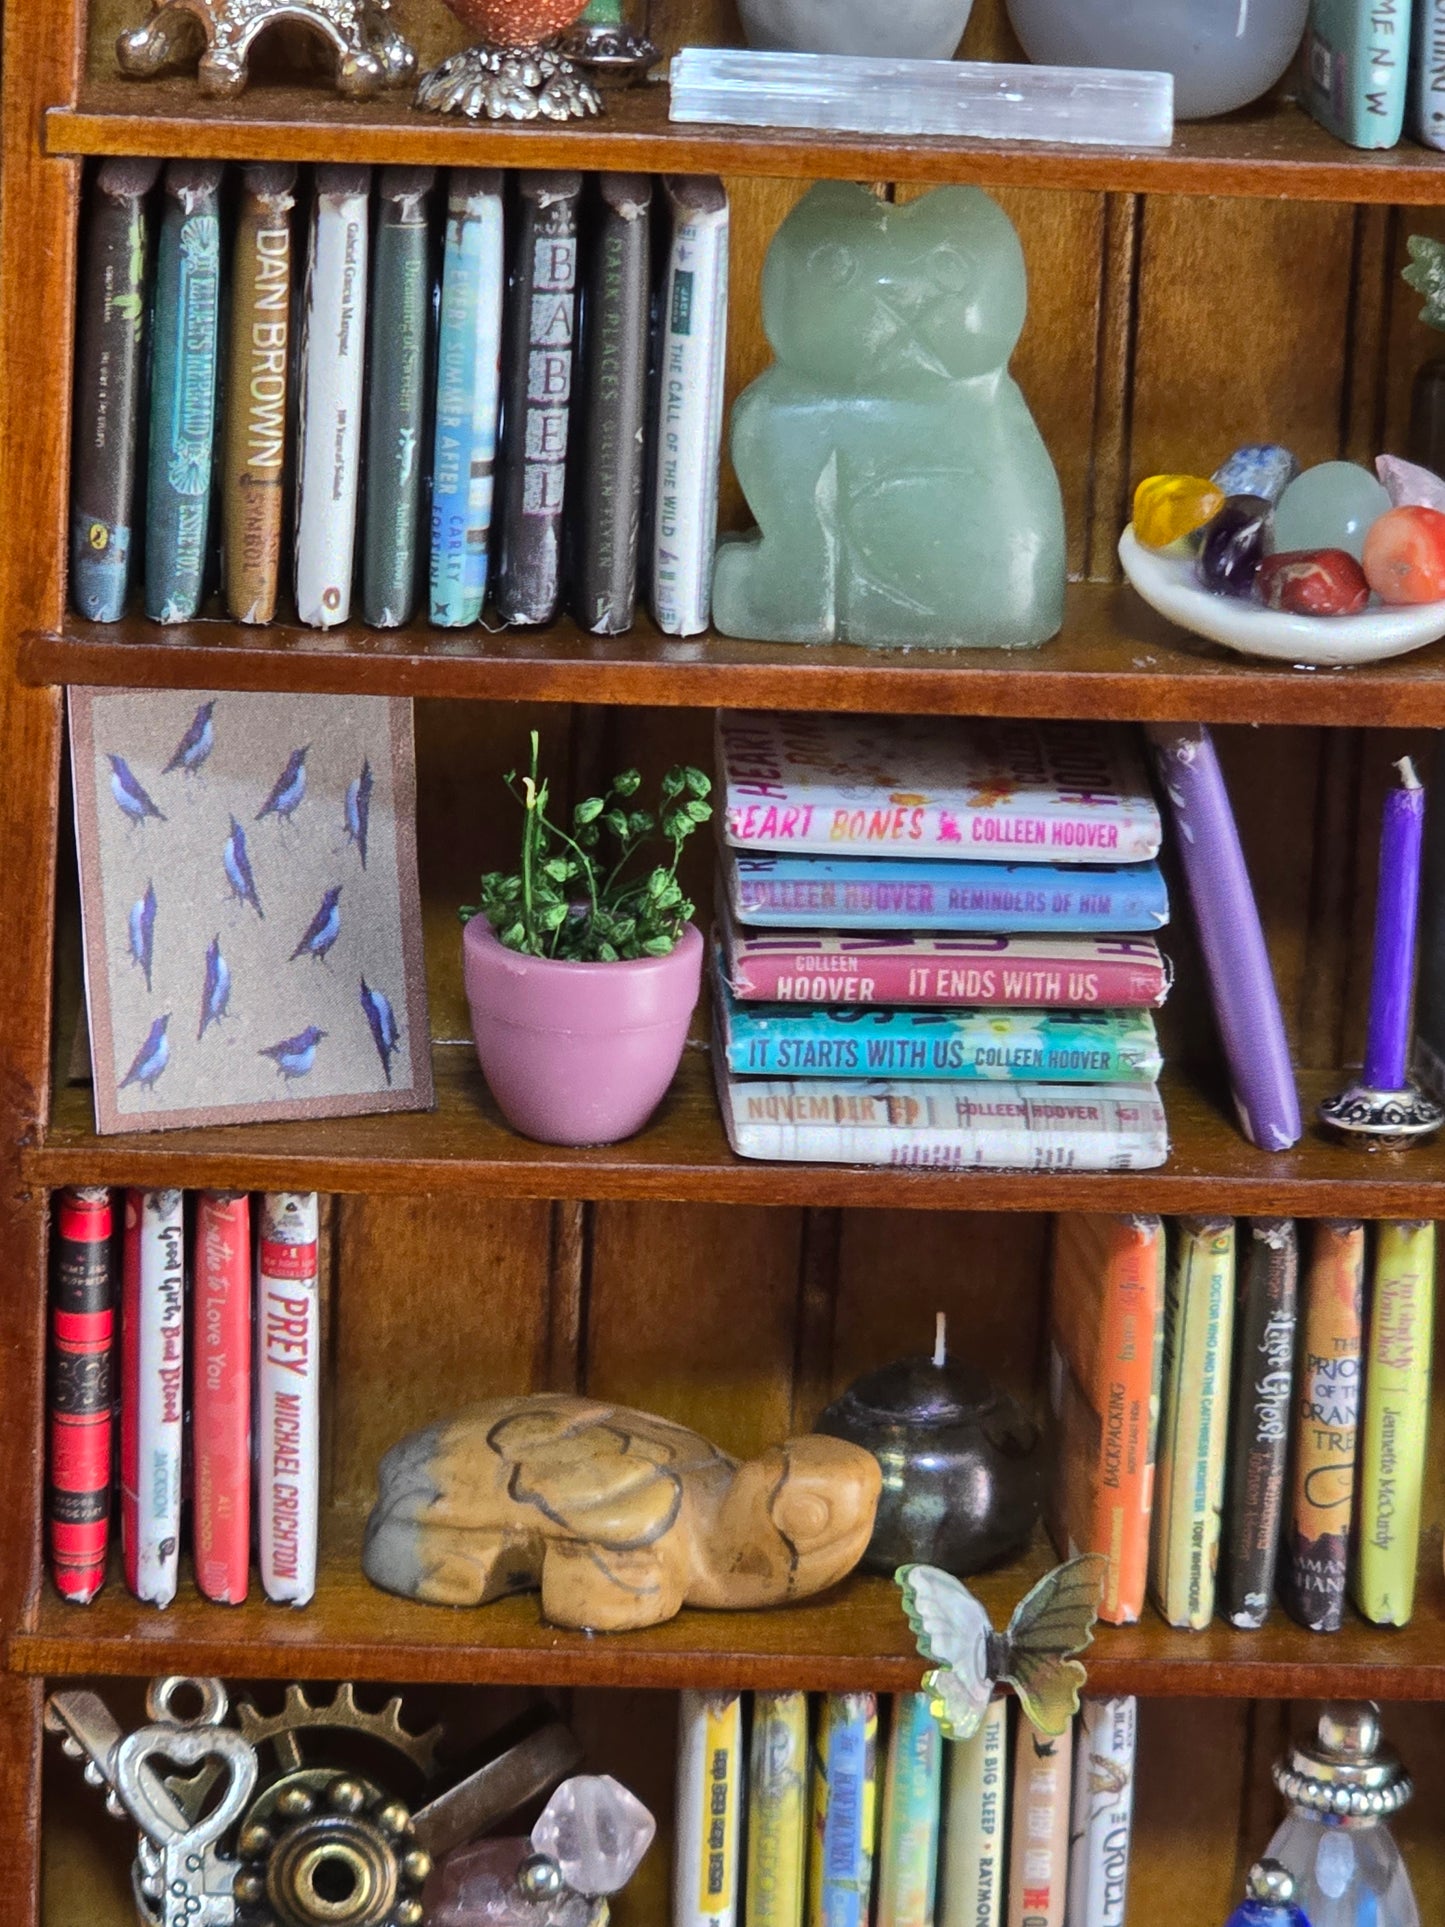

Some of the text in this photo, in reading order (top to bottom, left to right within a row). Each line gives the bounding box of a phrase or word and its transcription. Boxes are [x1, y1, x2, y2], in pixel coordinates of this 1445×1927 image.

[344, 222, 360, 264] Gabriel
[600, 237, 623, 400] DARK PLACES
[679, 287, 689, 318] JACK
[183, 278, 216, 436] ELIJAH'S MERMAID
[246, 229, 290, 468] DAN BROWN
[438, 269, 471, 495] EVERY SUMMER AFTER
[540, 244, 572, 509] BABEL
[660, 343, 685, 538] THE CALL OF THE WILD
[242, 491, 267, 572] SYMBOL
[447, 515, 465, 582] CARLEY
[831, 807, 926, 843] BONES
[972, 816, 1046, 845] COLLEEN
[1051, 821, 1118, 849] HOOVER
[741, 881, 1113, 915] COLLEEN HOOVER REMINDERS OF HIM
[777, 976, 875, 1001] HOOVER
[909, 969, 930, 997] IT
[937, 970, 996, 998] ENDS
[1003, 971, 1061, 1001] WITH
[1069, 974, 1099, 1001] US
[796, 955, 858, 972] COLLEEN
[749, 1040, 1111, 1069] IT STARTS WITH US COLLEEN HOOVER
[158, 1226, 182, 1271] Good
[203, 1206, 236, 1390] Loathe to Love You
[1208, 1274, 1223, 1320] DOCTOR
[160, 1325, 181, 1361] Bad
[266, 1291, 309, 1378] PREY
[1206, 1321, 1220, 1348] WHO
[1258, 1320, 1297, 1368] Last
[1204, 1350, 1217, 1372] AND
[158, 1366, 181, 1424] Blood
[1202, 1374, 1214, 1396] THE
[1254, 1370, 1294, 1443] Ghost
[1314, 1384, 1336, 1399] OF
[1101, 1381, 1127, 1489] BACKPACKING
[152, 1450, 169, 1519] JACKSON
[272, 1391, 302, 1581] MICHAEL CRICHTON
[1370, 1407, 1402, 1550] Jennette McCurdy
[1192, 1520, 1205, 1549] TOBY
[984, 1721, 1001, 1752] THE
[1112, 1712, 1127, 1753] BLACK
[982, 1757, 999, 1786] BIG
[980, 1792, 997, 1836] SLEEP
[1102, 1828, 1128, 1916] CRUEL
